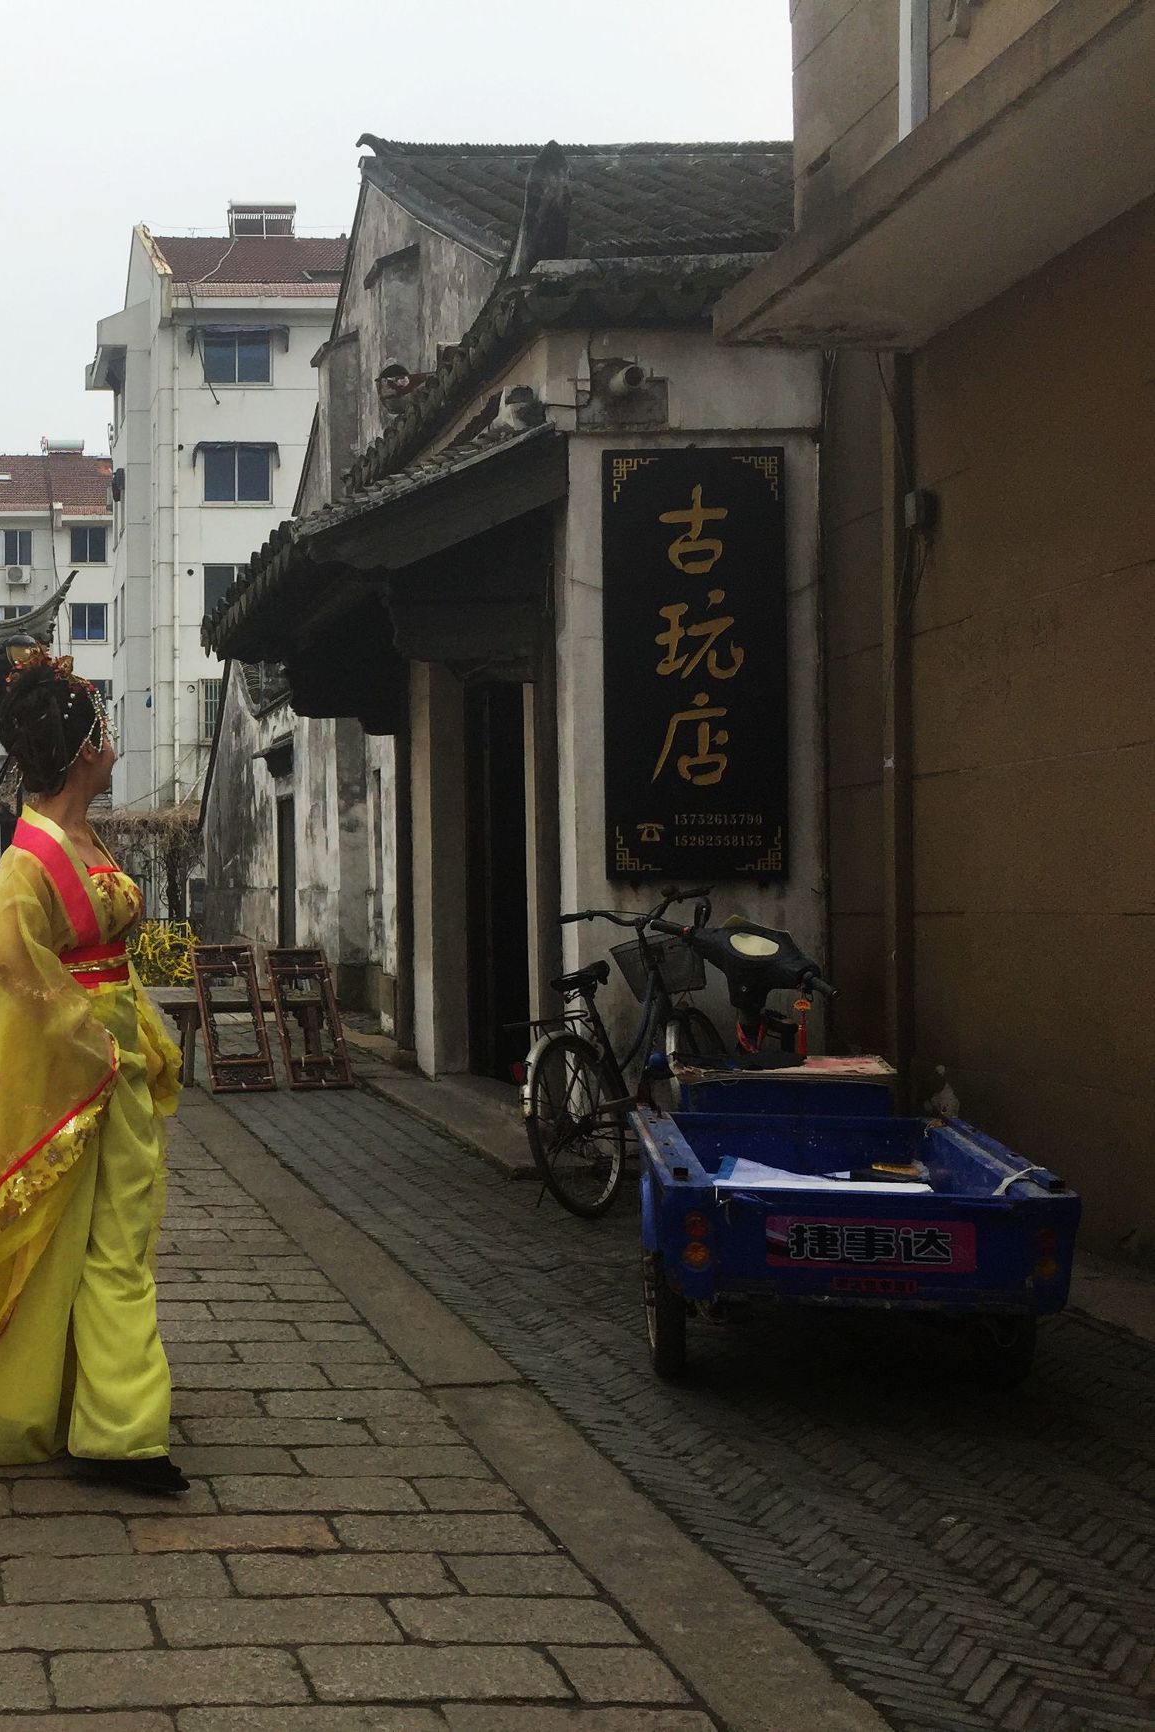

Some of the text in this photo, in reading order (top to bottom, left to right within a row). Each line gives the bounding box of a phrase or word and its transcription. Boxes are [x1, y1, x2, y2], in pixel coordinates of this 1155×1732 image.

[652, 483, 744, 786] 古玩店
[787, 1222, 953, 1265] 捷事达
